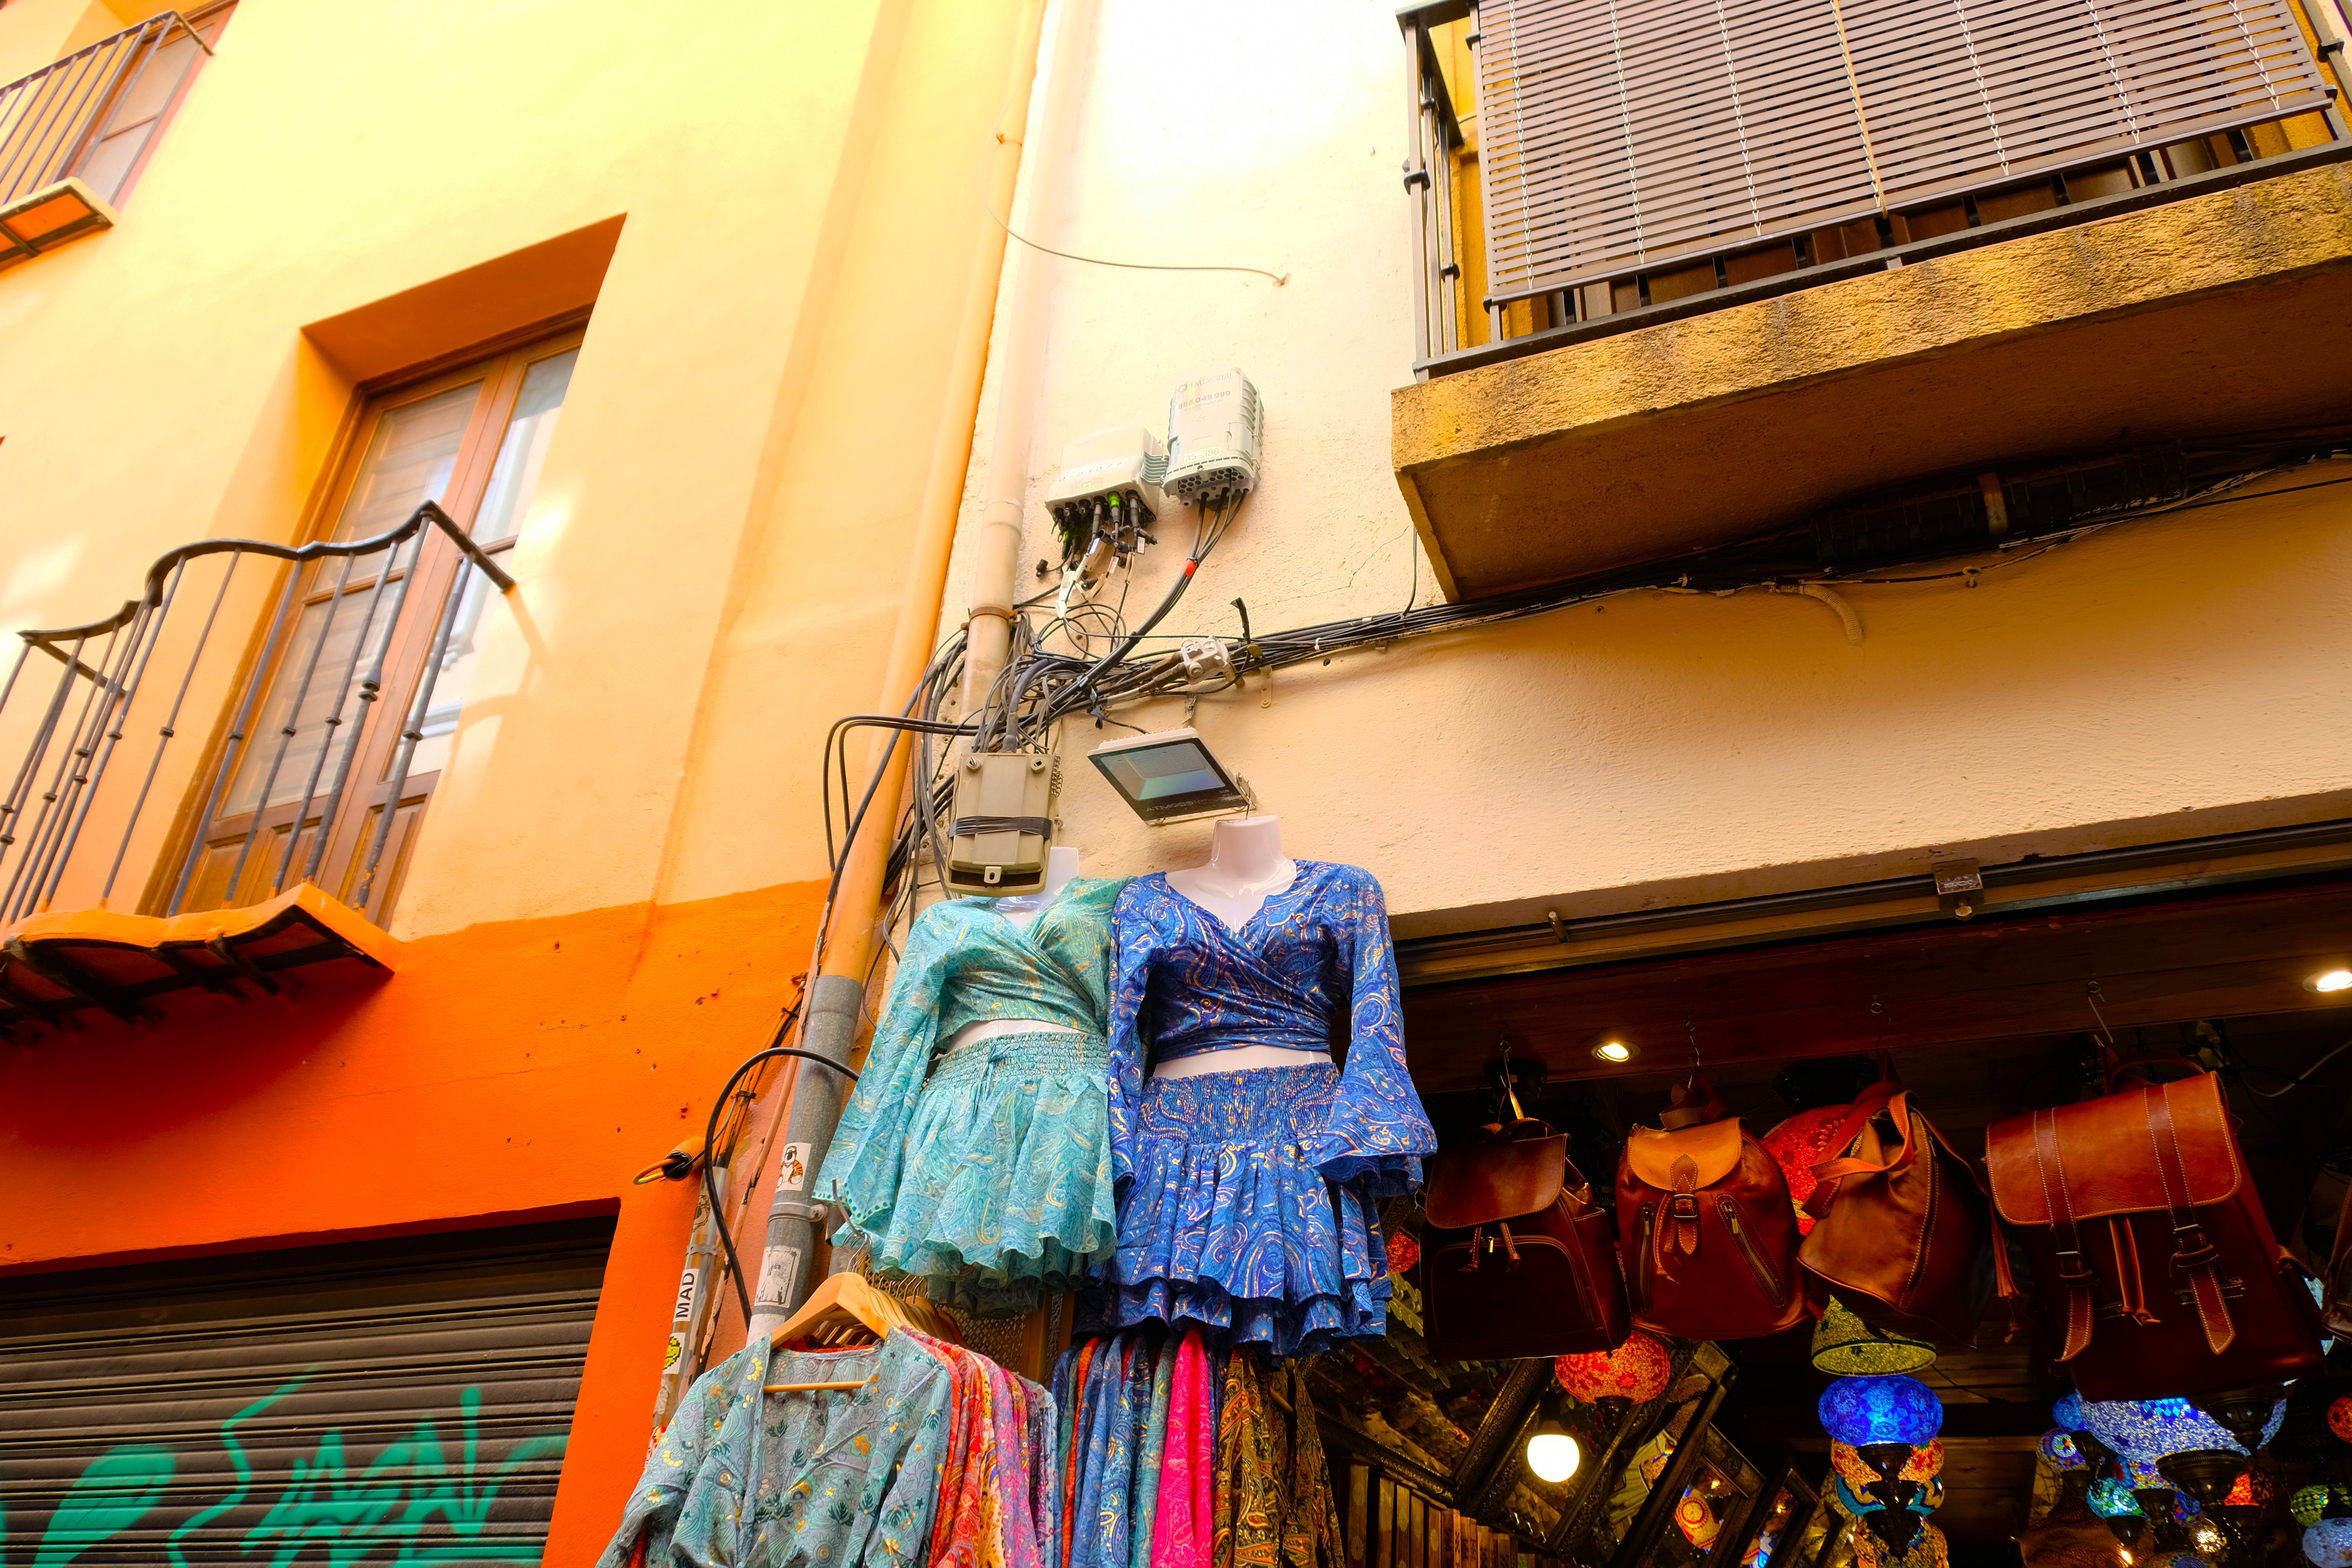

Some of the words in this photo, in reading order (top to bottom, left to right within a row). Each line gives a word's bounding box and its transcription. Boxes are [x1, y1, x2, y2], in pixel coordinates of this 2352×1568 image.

[1178, 399, 1193, 409] 958
[1196, 394, 1212, 403] 049
[1185, 448, 1219, 462] A5-388
[675, 1272, 695, 1318] MAD
